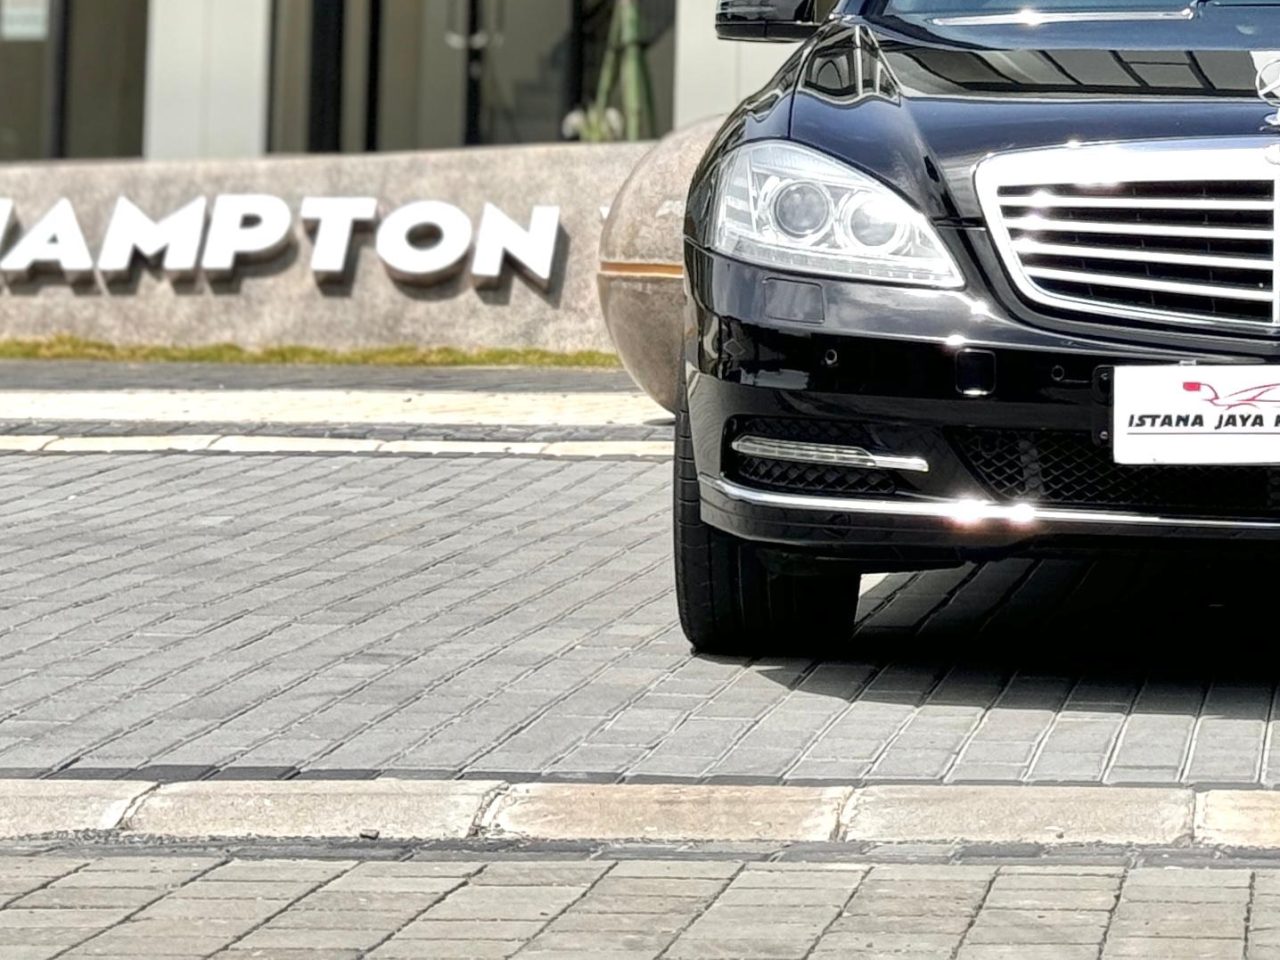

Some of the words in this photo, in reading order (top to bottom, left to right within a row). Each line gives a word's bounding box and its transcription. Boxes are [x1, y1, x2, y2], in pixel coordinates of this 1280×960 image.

[0, 193, 561, 281] AMPTON
[1128, 414, 1204, 428] ISTANA
[1214, 414, 1265, 430] JAYA
